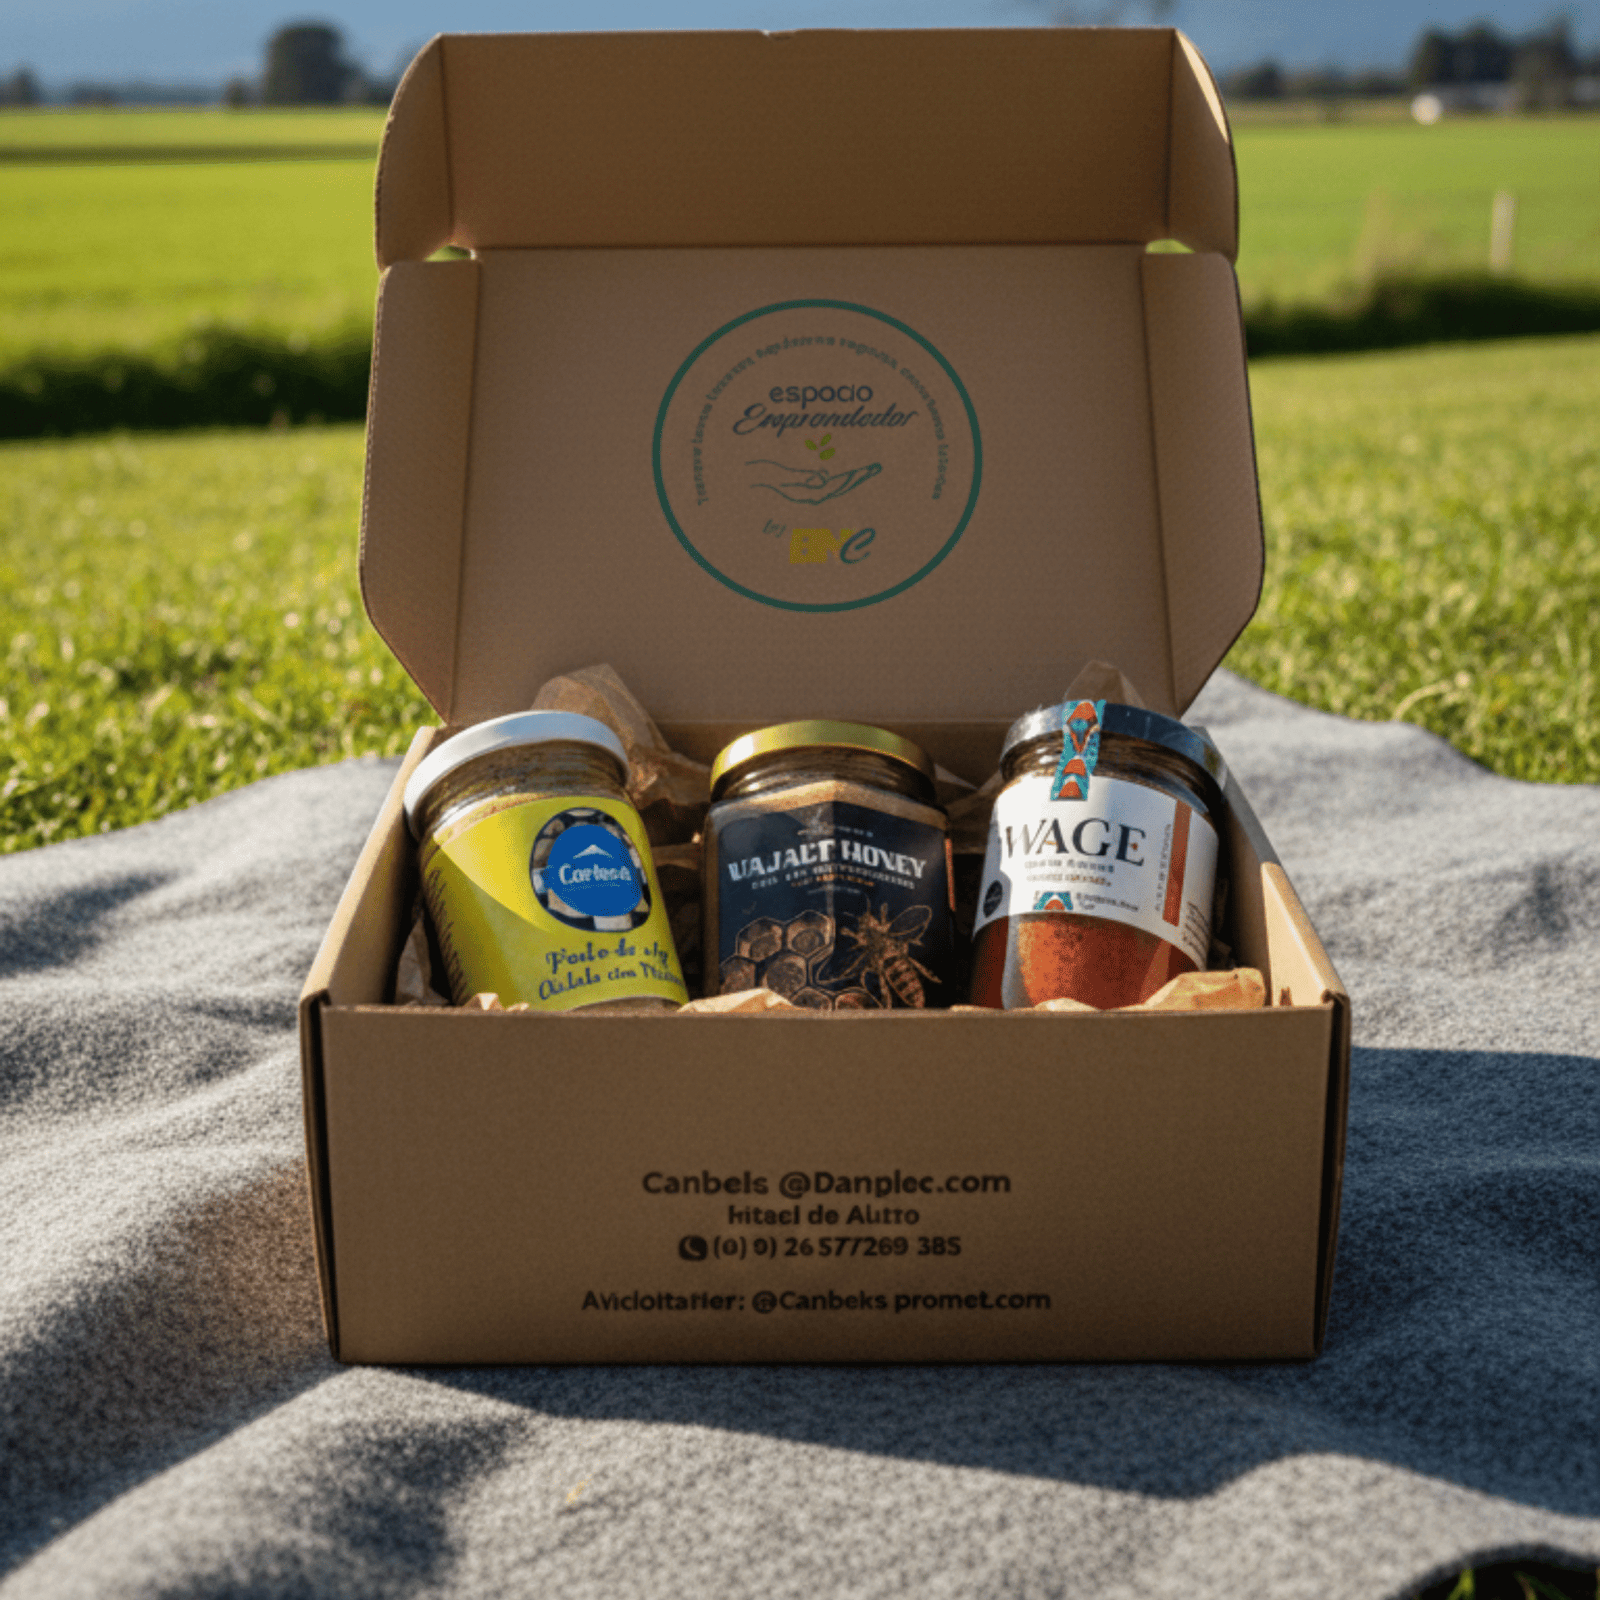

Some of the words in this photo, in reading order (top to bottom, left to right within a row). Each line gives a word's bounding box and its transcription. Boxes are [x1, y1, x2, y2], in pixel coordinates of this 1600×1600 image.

[1005, 817, 1147, 867] WAGE
[642, 1170, 769, 1194] Canbels
[808, 1204, 839, 1225] de
